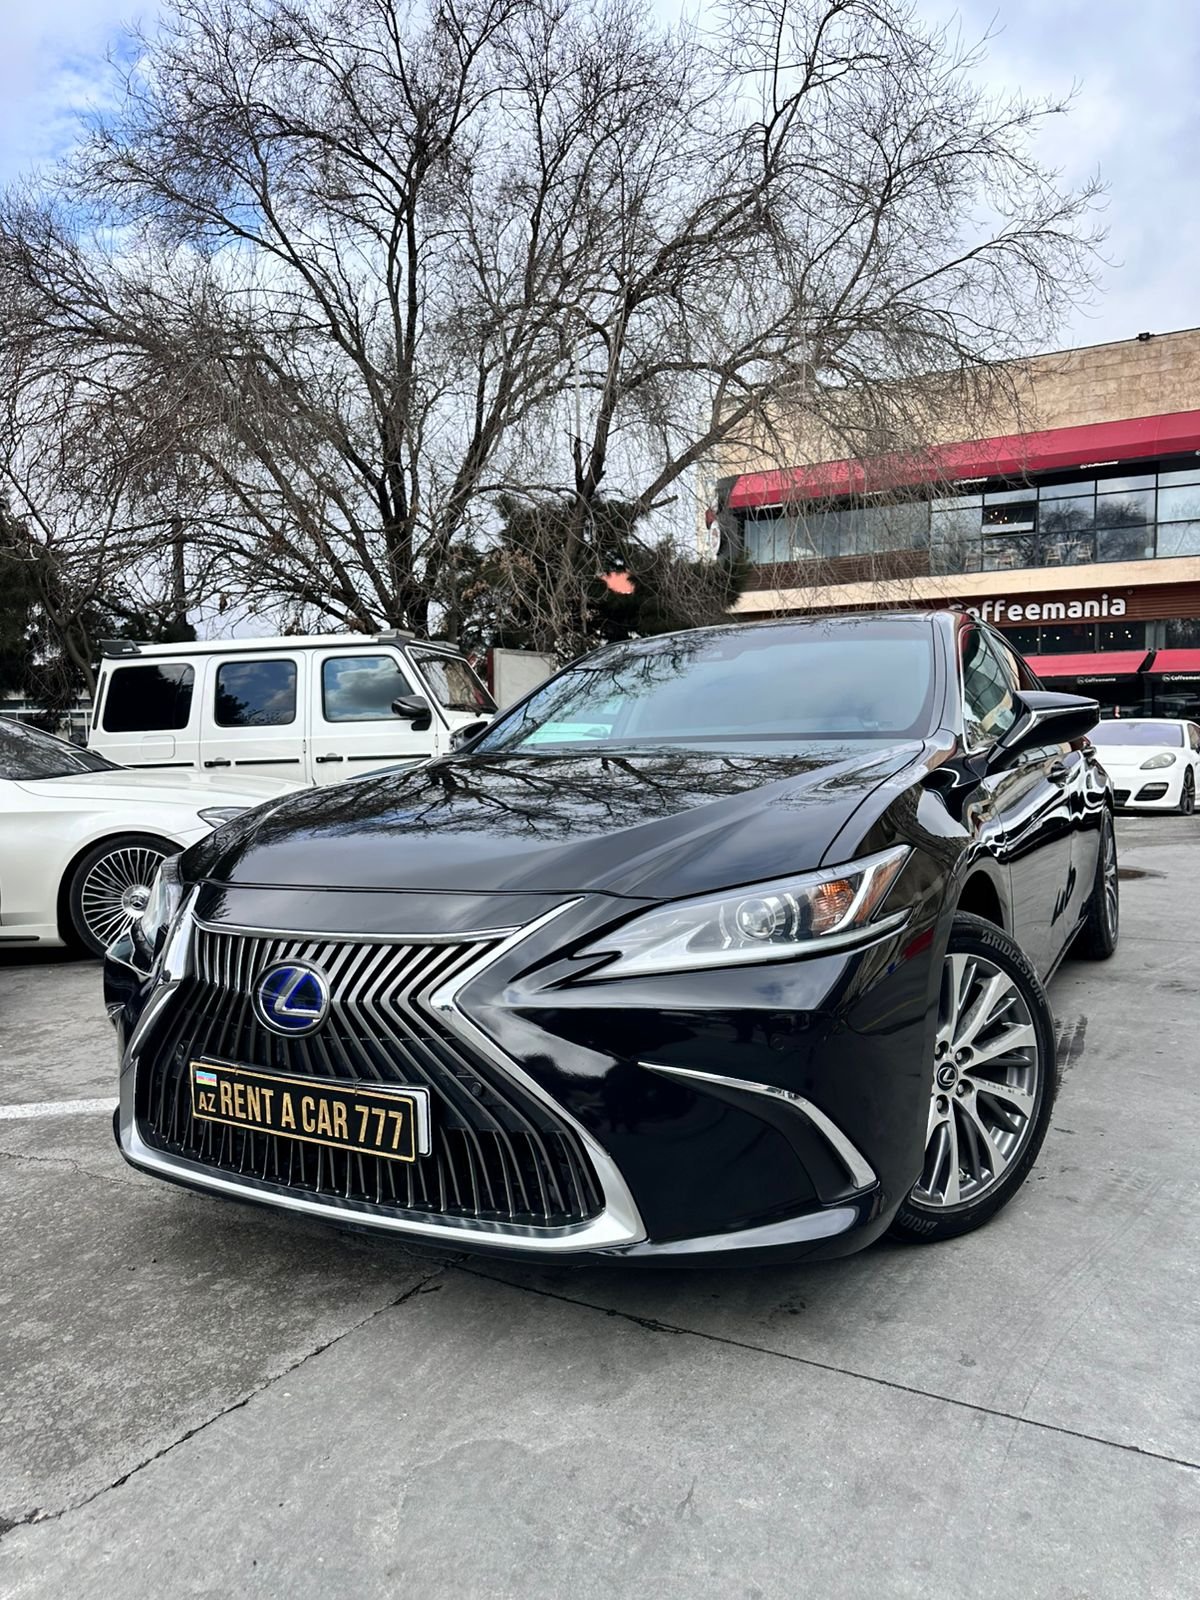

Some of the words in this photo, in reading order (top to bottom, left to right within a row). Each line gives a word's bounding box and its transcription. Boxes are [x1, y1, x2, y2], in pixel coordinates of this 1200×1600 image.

[981, 929, 1046, 1007] BRIDGESTONE
[198, 1091, 217, 1113] AZ
[219, 1080, 274, 1124] RENT
[281, 1092, 297, 1130] A
[301, 1095, 349, 1140] CAR
[354, 1104, 403, 1150] 777
